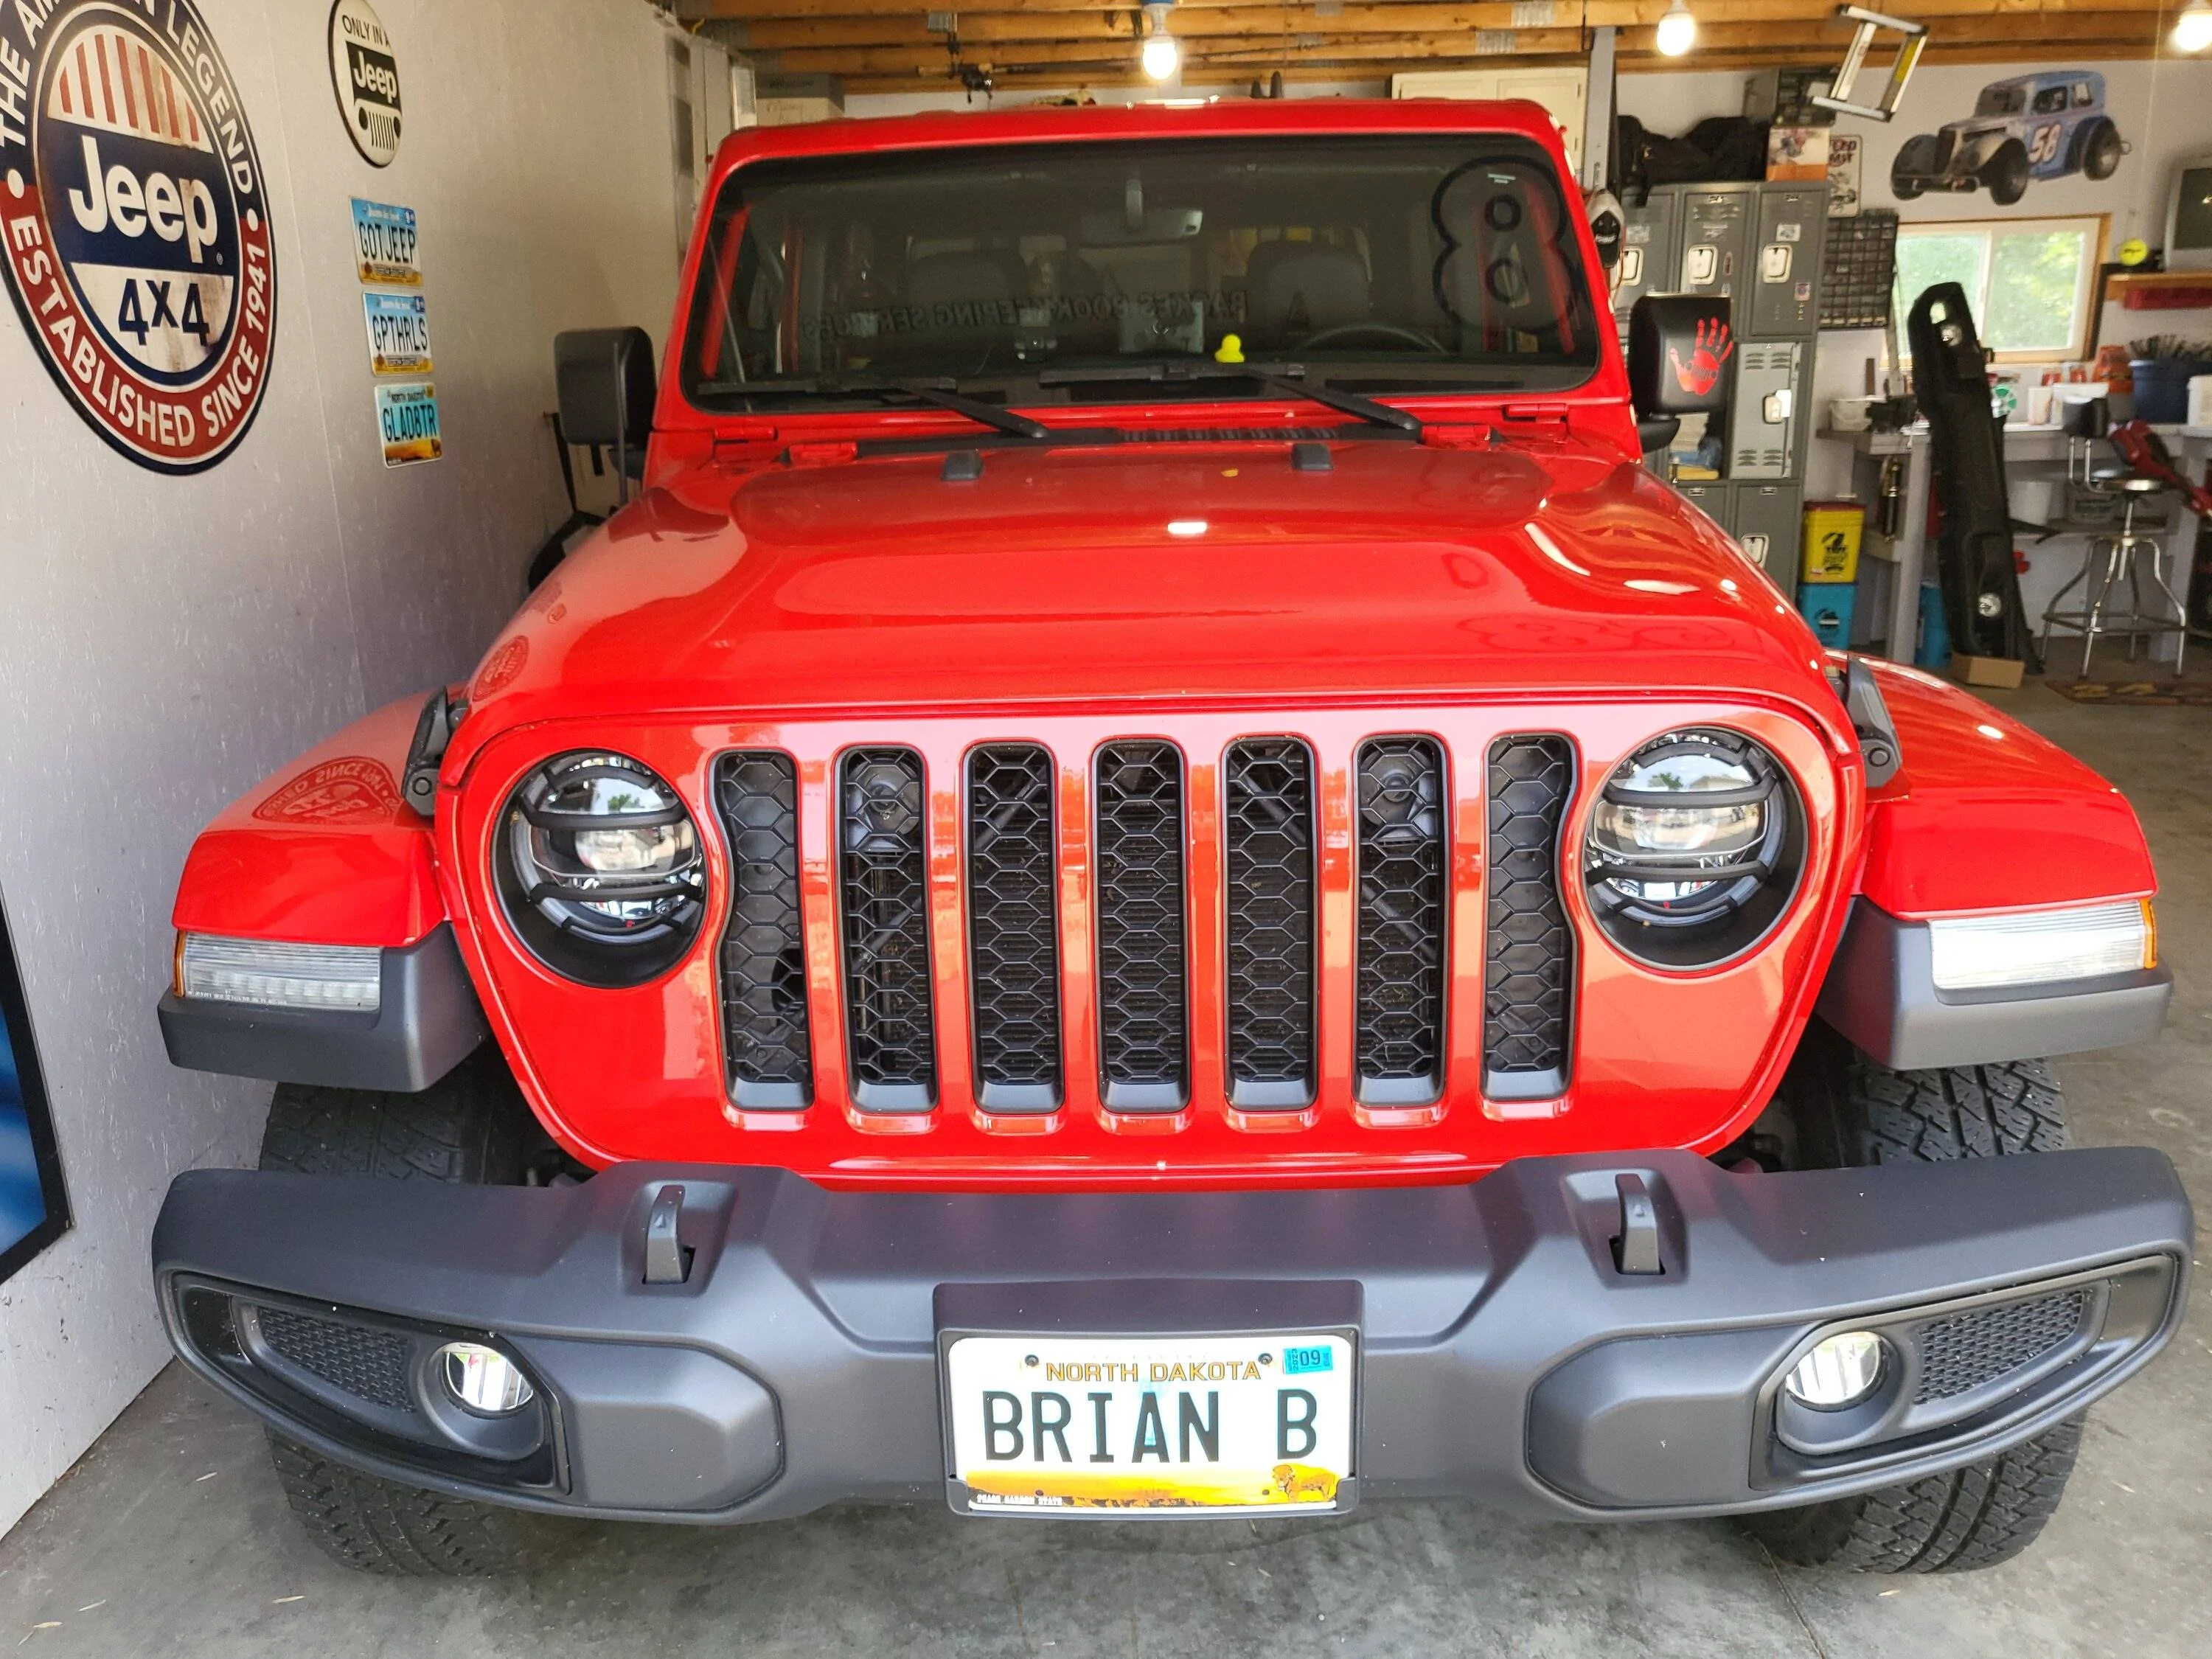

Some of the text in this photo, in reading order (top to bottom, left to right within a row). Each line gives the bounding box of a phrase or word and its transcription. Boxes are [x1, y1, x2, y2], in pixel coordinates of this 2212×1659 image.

[342, 15, 369, 41] ONLY
[372, 25, 383, 46] IN
[0, 37, 30, 147] THE
[167, 0, 253, 194] LEGEND
[353, 50, 397, 103] Jeep
[69, 135, 219, 264] Jeep
[358, 221, 416, 265] GOT JEEP
[12, 216, 266, 448] ESTABLISHED SINCE 1941
[118, 278, 211, 346] 4X4
[372, 314, 428, 352] GPTHRLS
[1046, 1361, 1261, 1382] NORTH DAKOTA
[1300, 1349, 1321, 1366] 09
[982, 1388, 1318, 1464] BRIAN B
